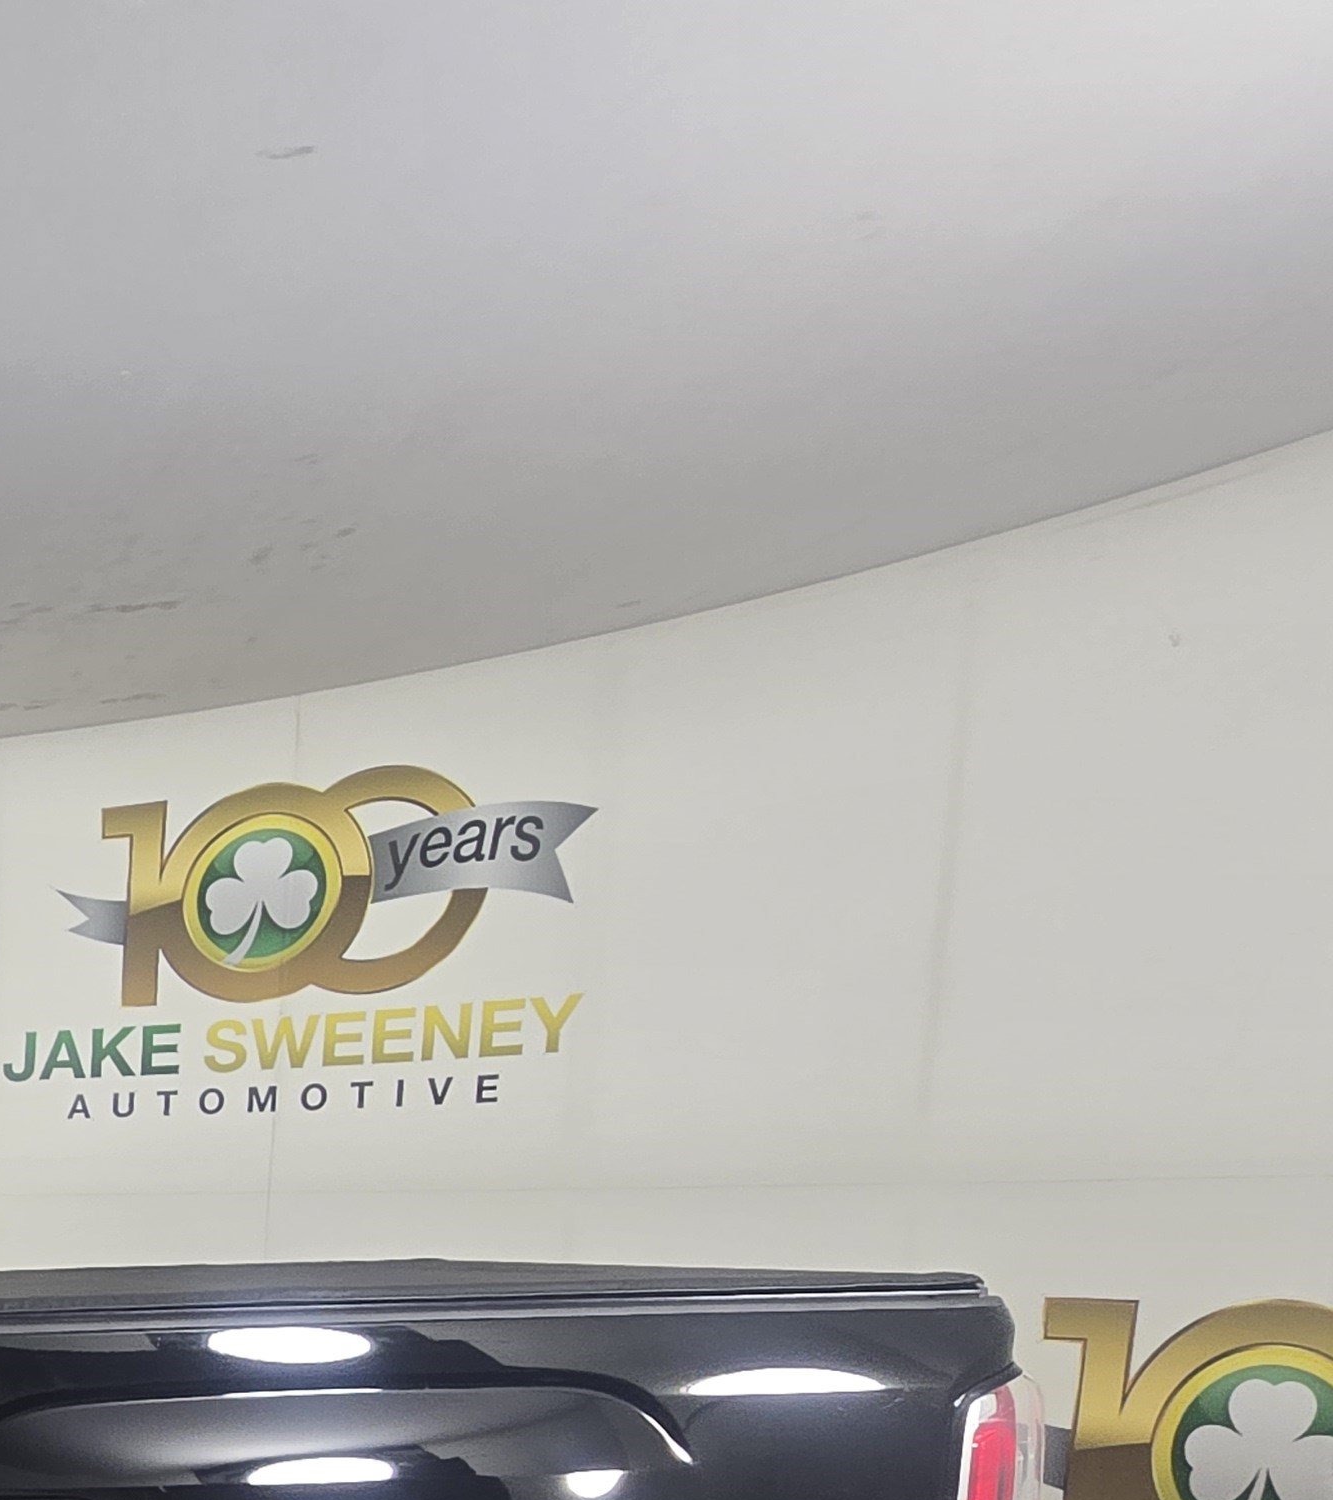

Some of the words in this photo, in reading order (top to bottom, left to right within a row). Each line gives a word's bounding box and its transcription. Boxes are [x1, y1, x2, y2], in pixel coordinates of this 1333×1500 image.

[100, 764, 488, 1007] 100
[384, 810, 544, 891] years
[3, 1023, 181, 1082] JAKE
[203, 992, 585, 1073] SWEENEY
[66, 1074, 500, 1119] AUTOMOTIVE
